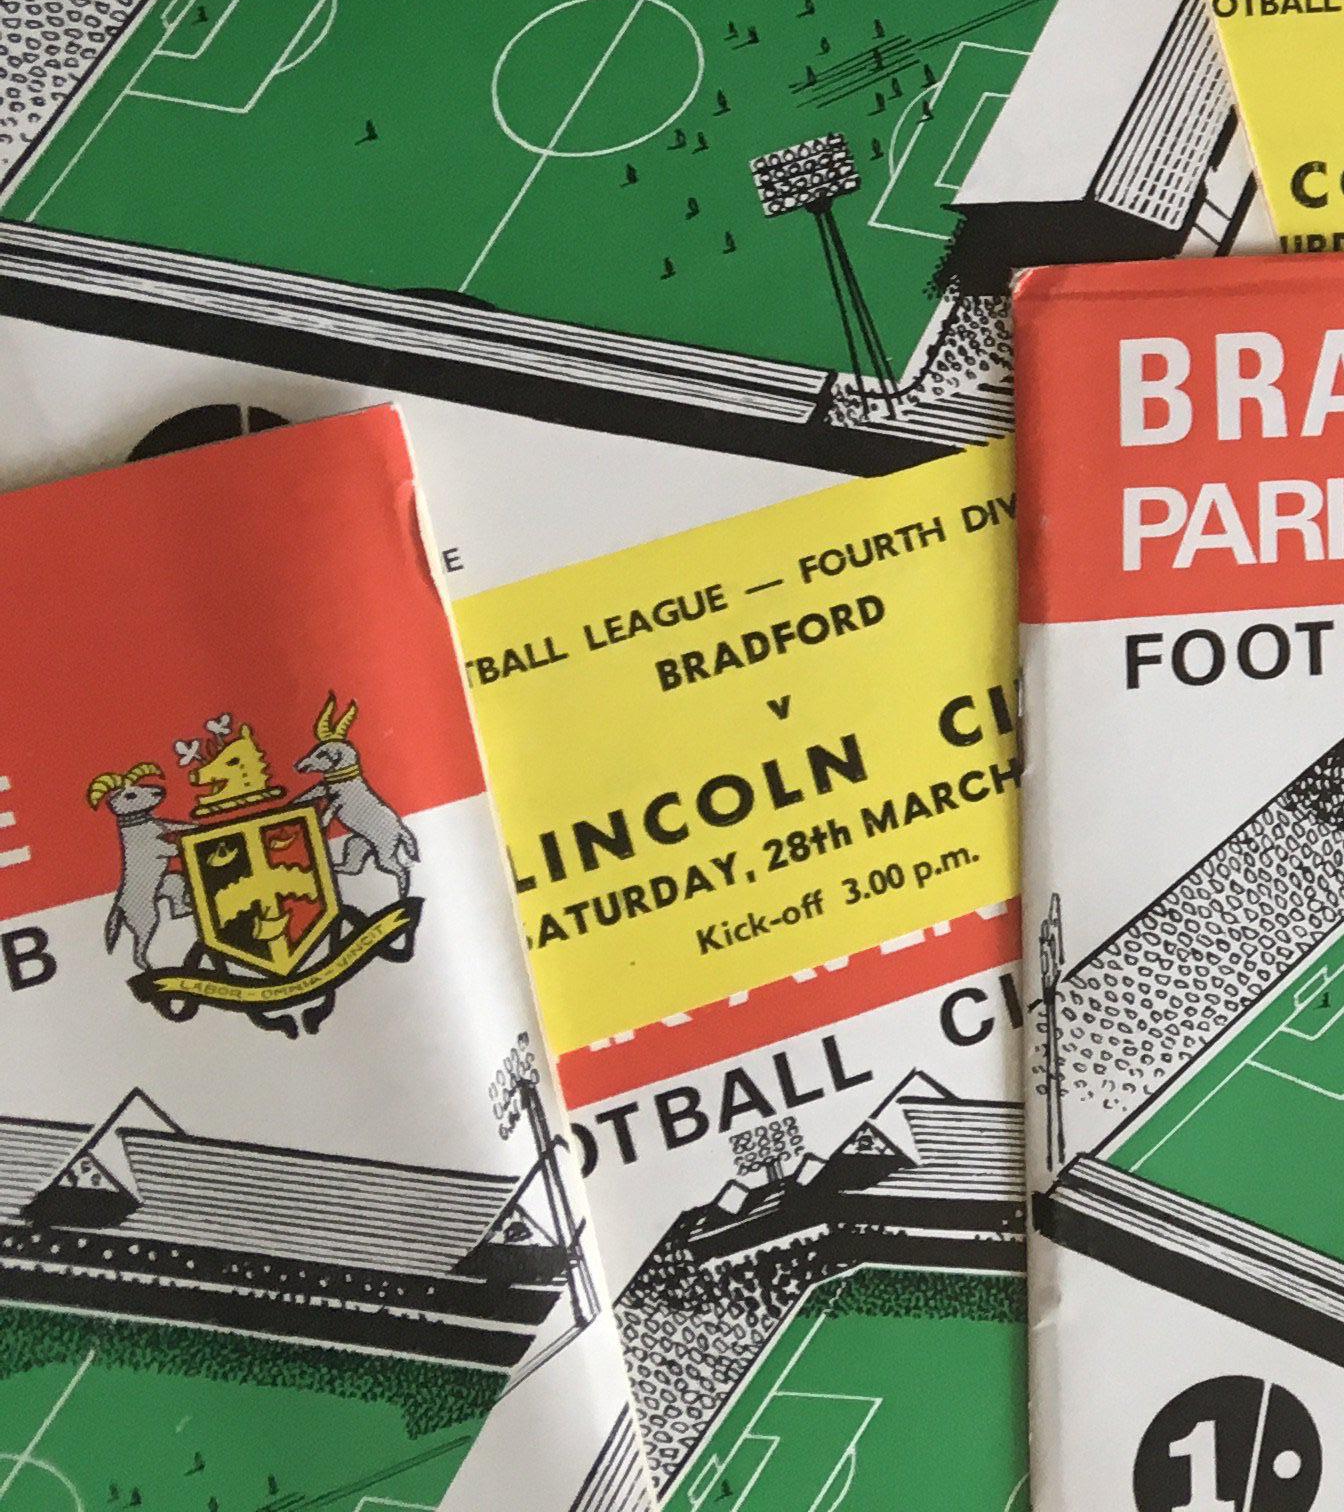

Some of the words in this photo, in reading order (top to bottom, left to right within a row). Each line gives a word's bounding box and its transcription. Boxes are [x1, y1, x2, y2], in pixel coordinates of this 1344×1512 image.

[584, 583, 729, 651] LEAGUE
[800, 516, 946, 585] FOURTH
[656, 594, 886, 692] BRADFORD
[767, 696, 791, 720] v
[508, 733, 869, 893] LINCOLN
[763, 819, 853, 873] 28th
[696, 889, 825, 956] Kick-off
[843, 862, 905, 907] 3.00
[914, 843, 981, 889] p.m.
